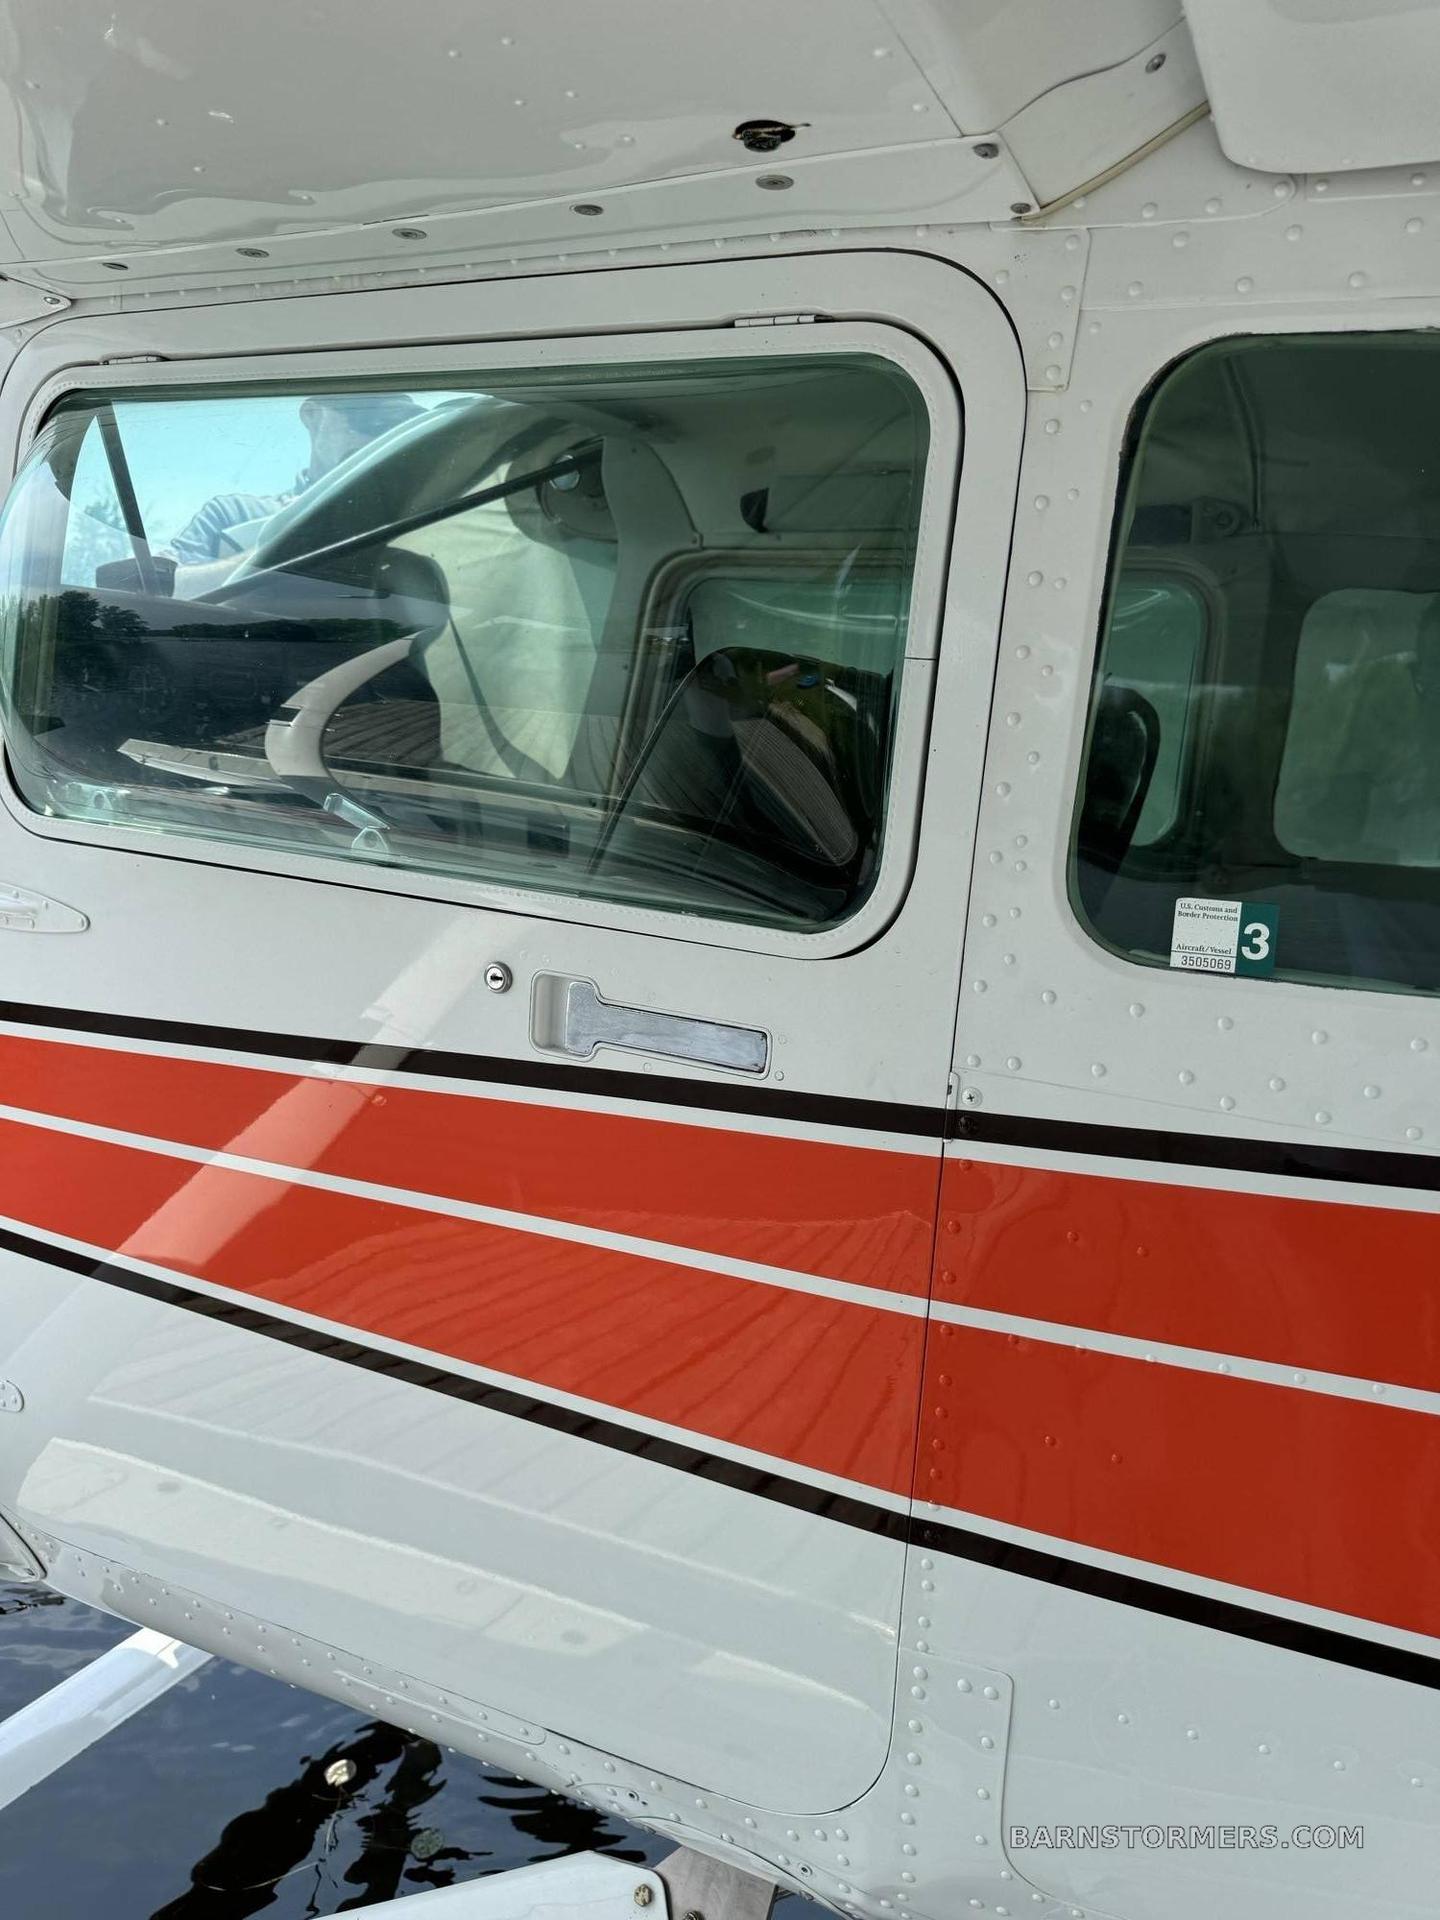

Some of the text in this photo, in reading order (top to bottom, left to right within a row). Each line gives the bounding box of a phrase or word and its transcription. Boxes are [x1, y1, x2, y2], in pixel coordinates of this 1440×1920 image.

[1194, 903, 1223, 913] Customs
[1224, 906, 1238, 914] and
[1202, 913, 1238, 922] Protection
[1241, 922, 1270, 960] 3
[1181, 955, 1232, 970] 3505069
